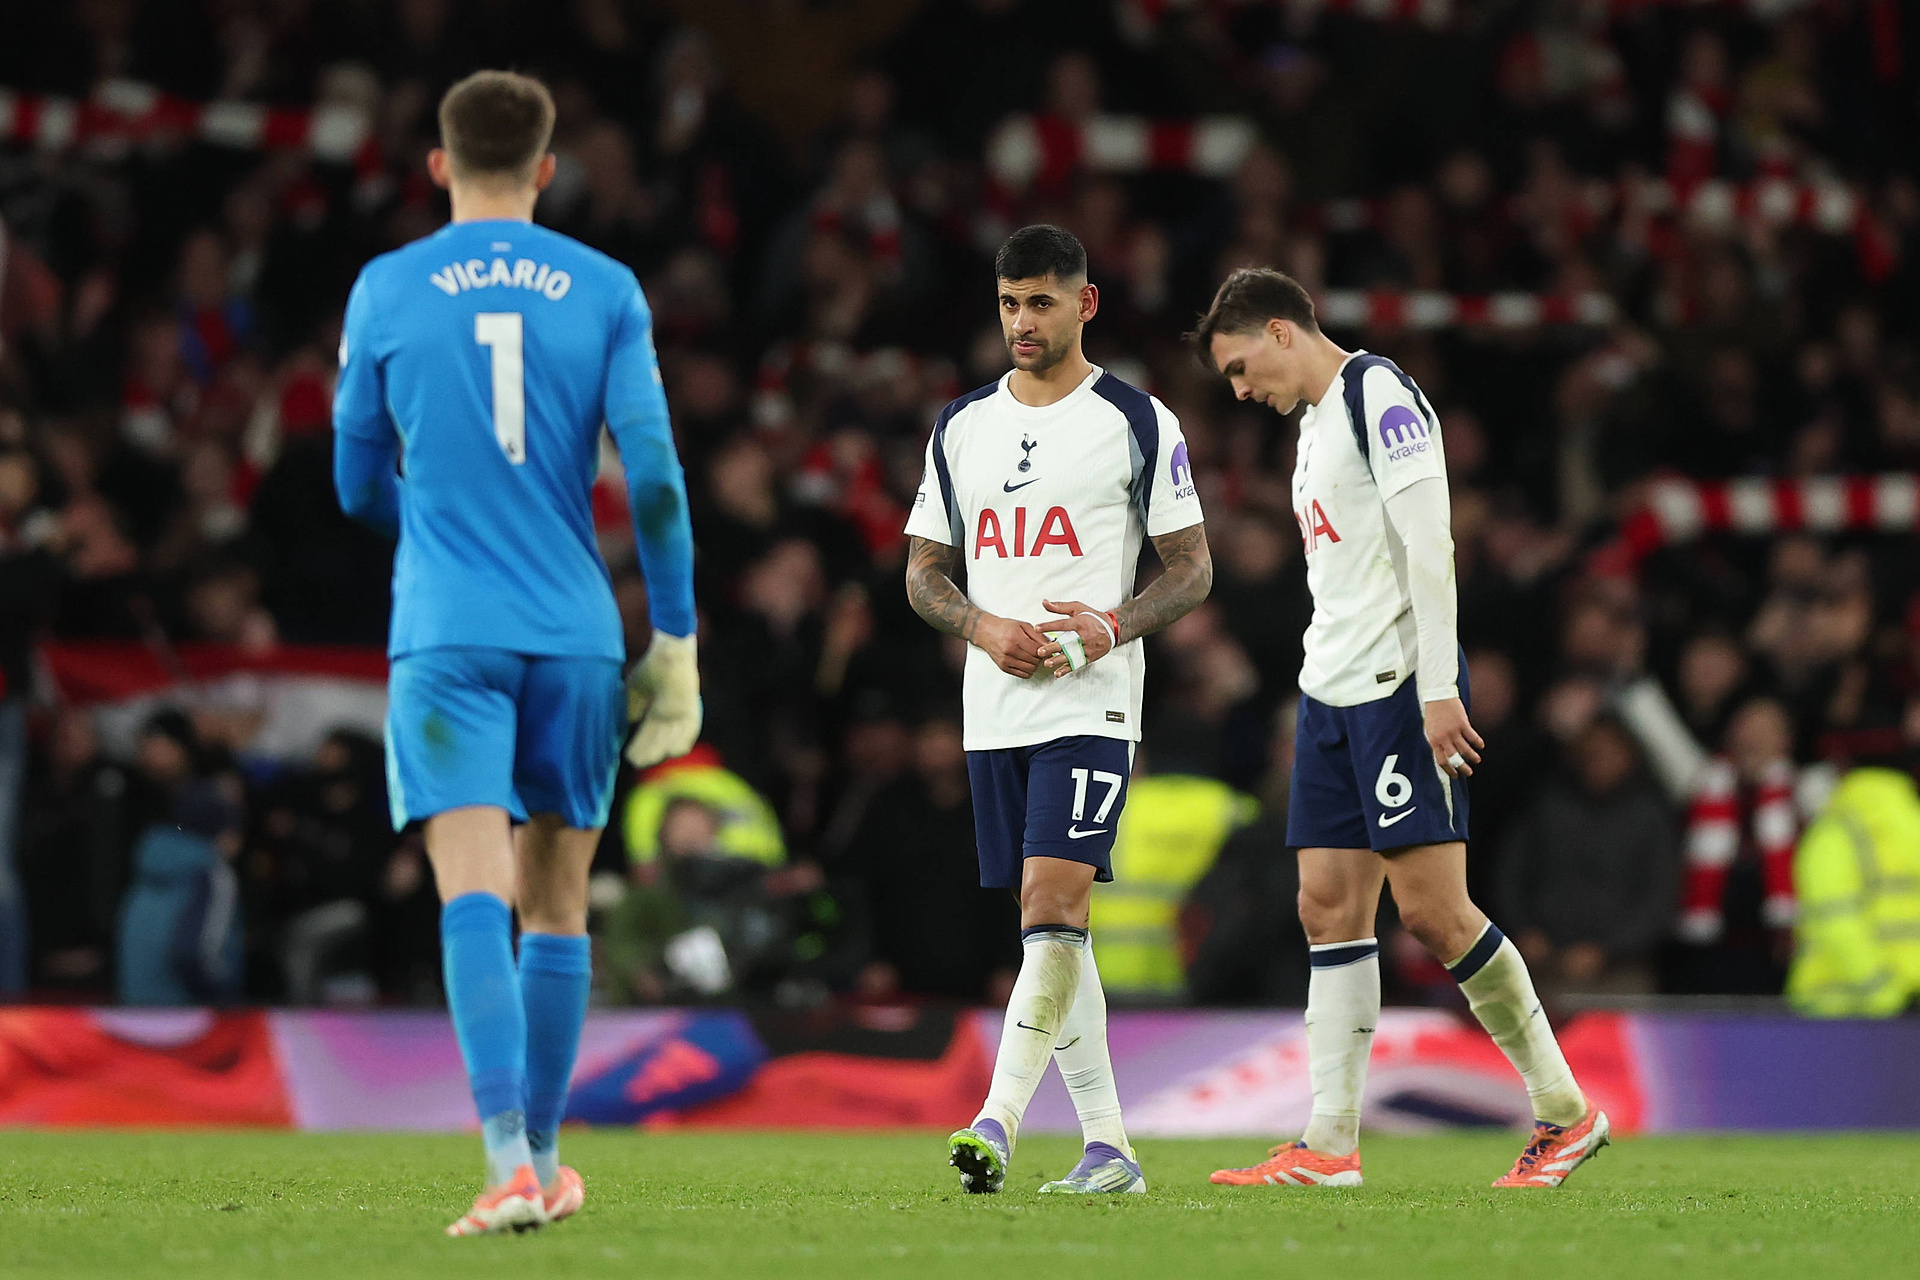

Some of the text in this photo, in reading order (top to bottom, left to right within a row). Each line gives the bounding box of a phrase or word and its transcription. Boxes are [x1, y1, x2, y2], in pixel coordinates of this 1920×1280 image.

[430, 257, 572, 301] VICARIO
[474, 312, 526, 466] 1
[1389, 441, 1431, 462] kraken
[975, 506, 1084, 560] AIA
[1071, 767, 1123, 824] 17
[1375, 754, 1413, 808] 6
